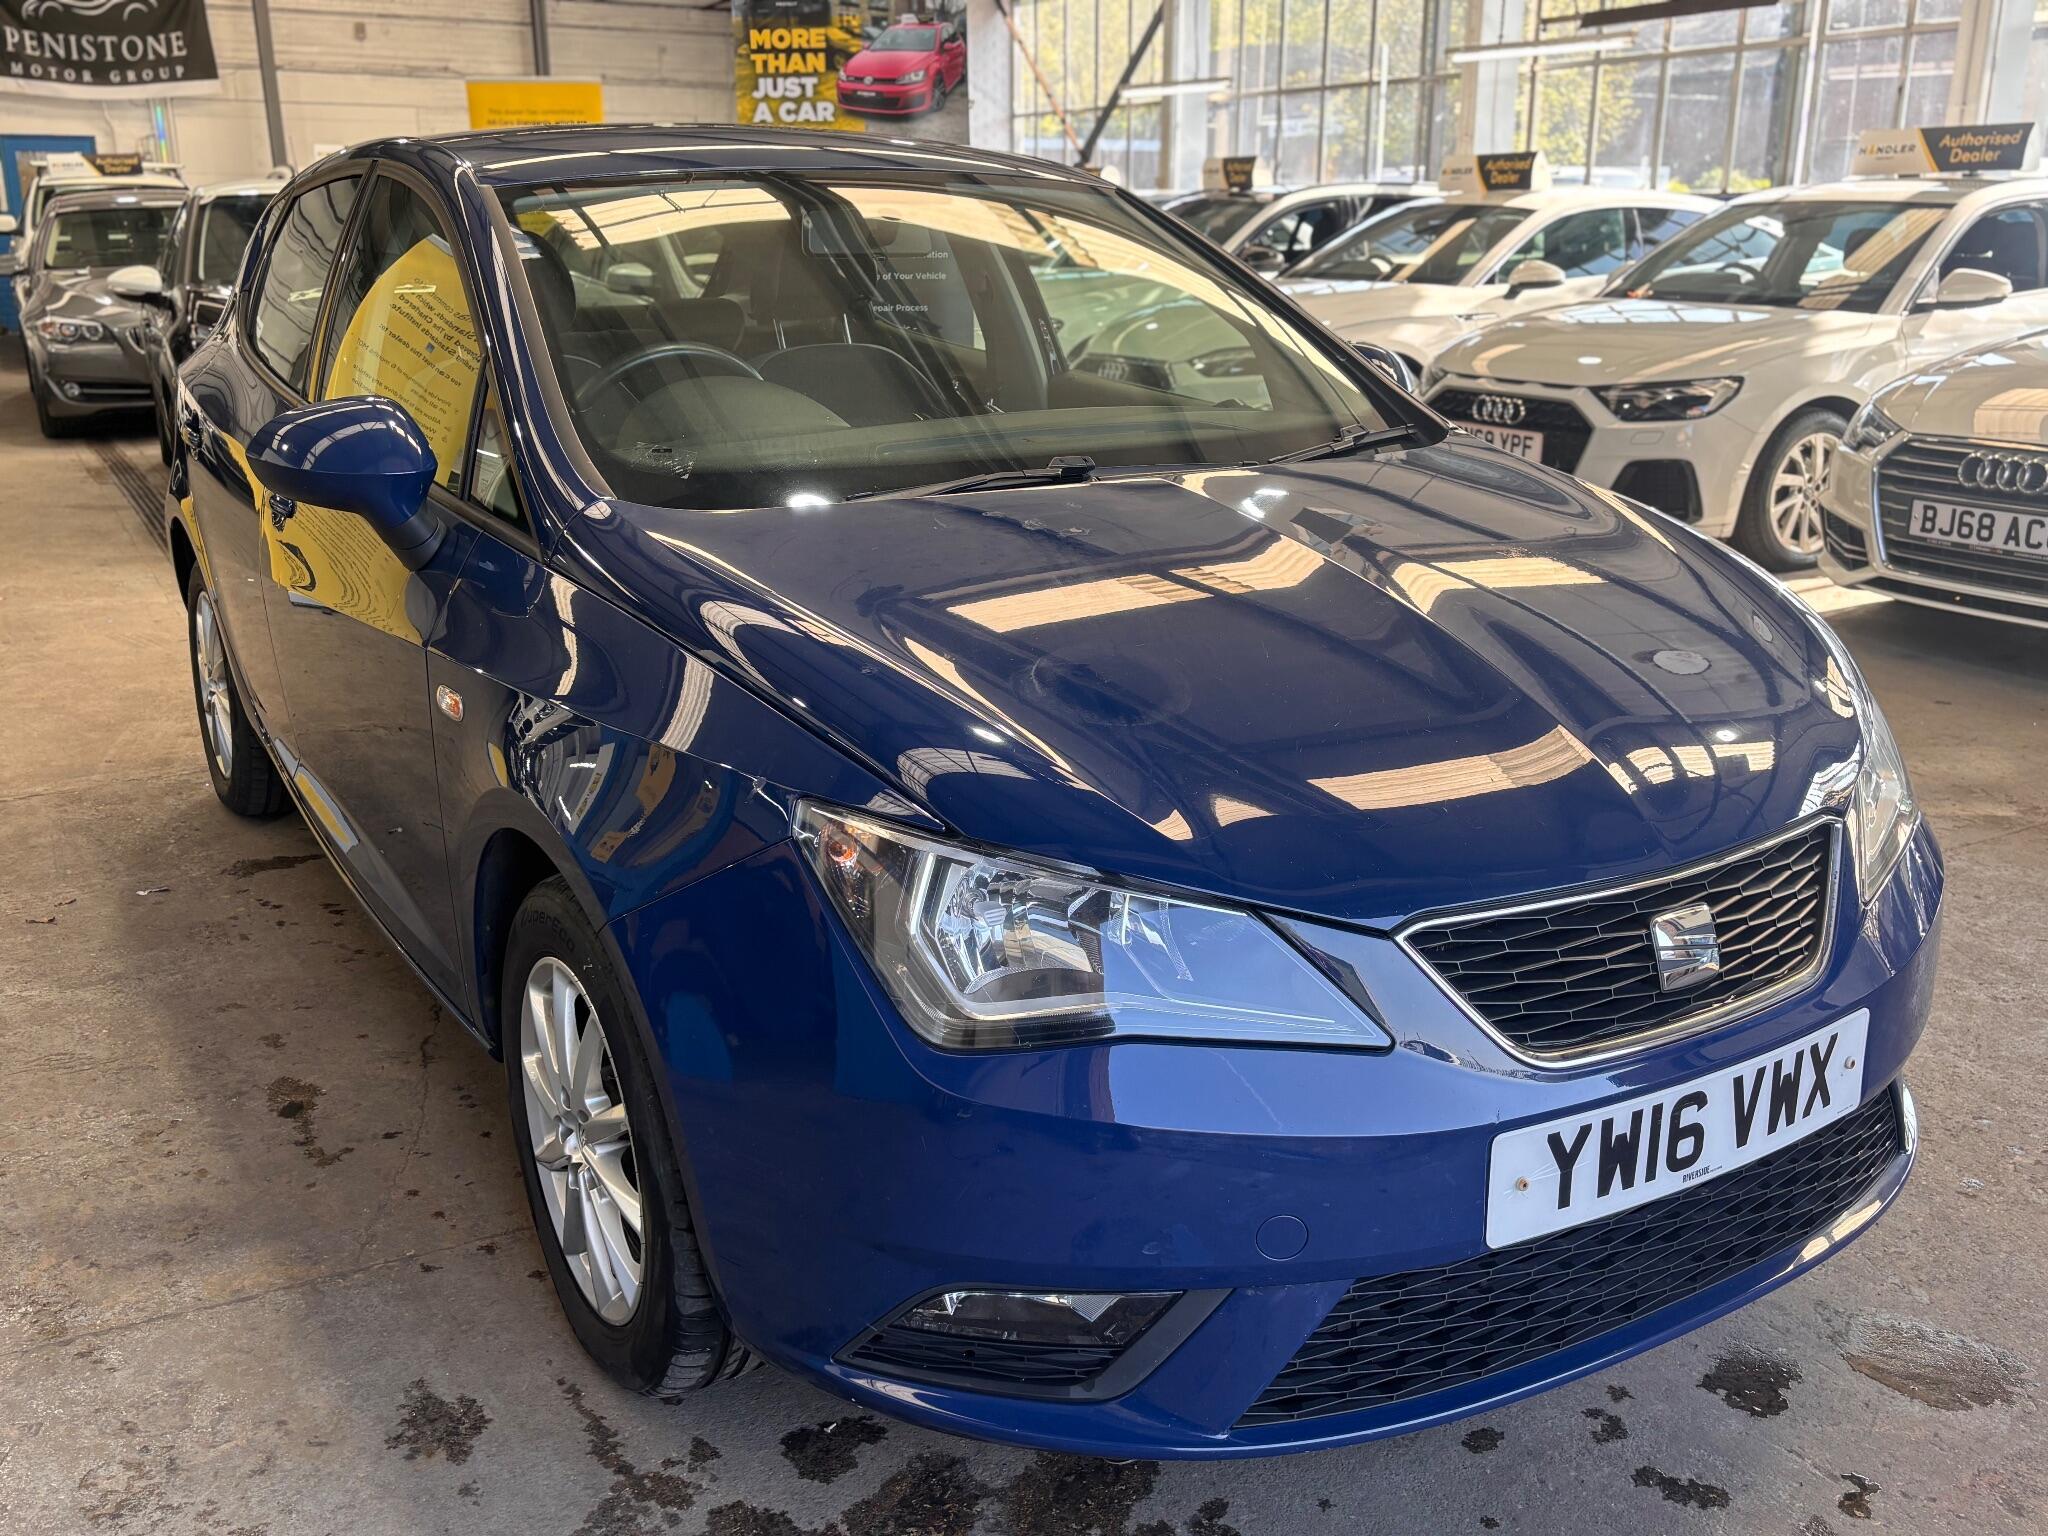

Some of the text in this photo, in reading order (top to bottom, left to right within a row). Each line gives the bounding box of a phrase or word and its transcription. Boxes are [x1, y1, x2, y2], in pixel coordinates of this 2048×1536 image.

[3, 26, 188, 62] PENISTONE
[750, 28, 826, 49] MORE
[10, 61, 185, 83] MOTOR GROUP
[751, 53, 826, 74] THAN
[752, 77, 818, 99] JUST
[753, 101, 835, 123] A CAR
[1939, 129, 2023, 148] Authorised
[1950, 146, 2001, 163] Dealer
[882, 272, 891, 280] of
[894, 272, 914, 280] Your
[915, 271, 947, 280] Vehicle
[873, 303, 928, 312] epair Process
[1500, 431, 1534, 457] YPF
[1920, 504, 2048, 550] BJ68 AC
[1547, 1032, 1839, 1210] YW16 VWX
[1682, 1165, 1710, 1183] RIVERSIDE
